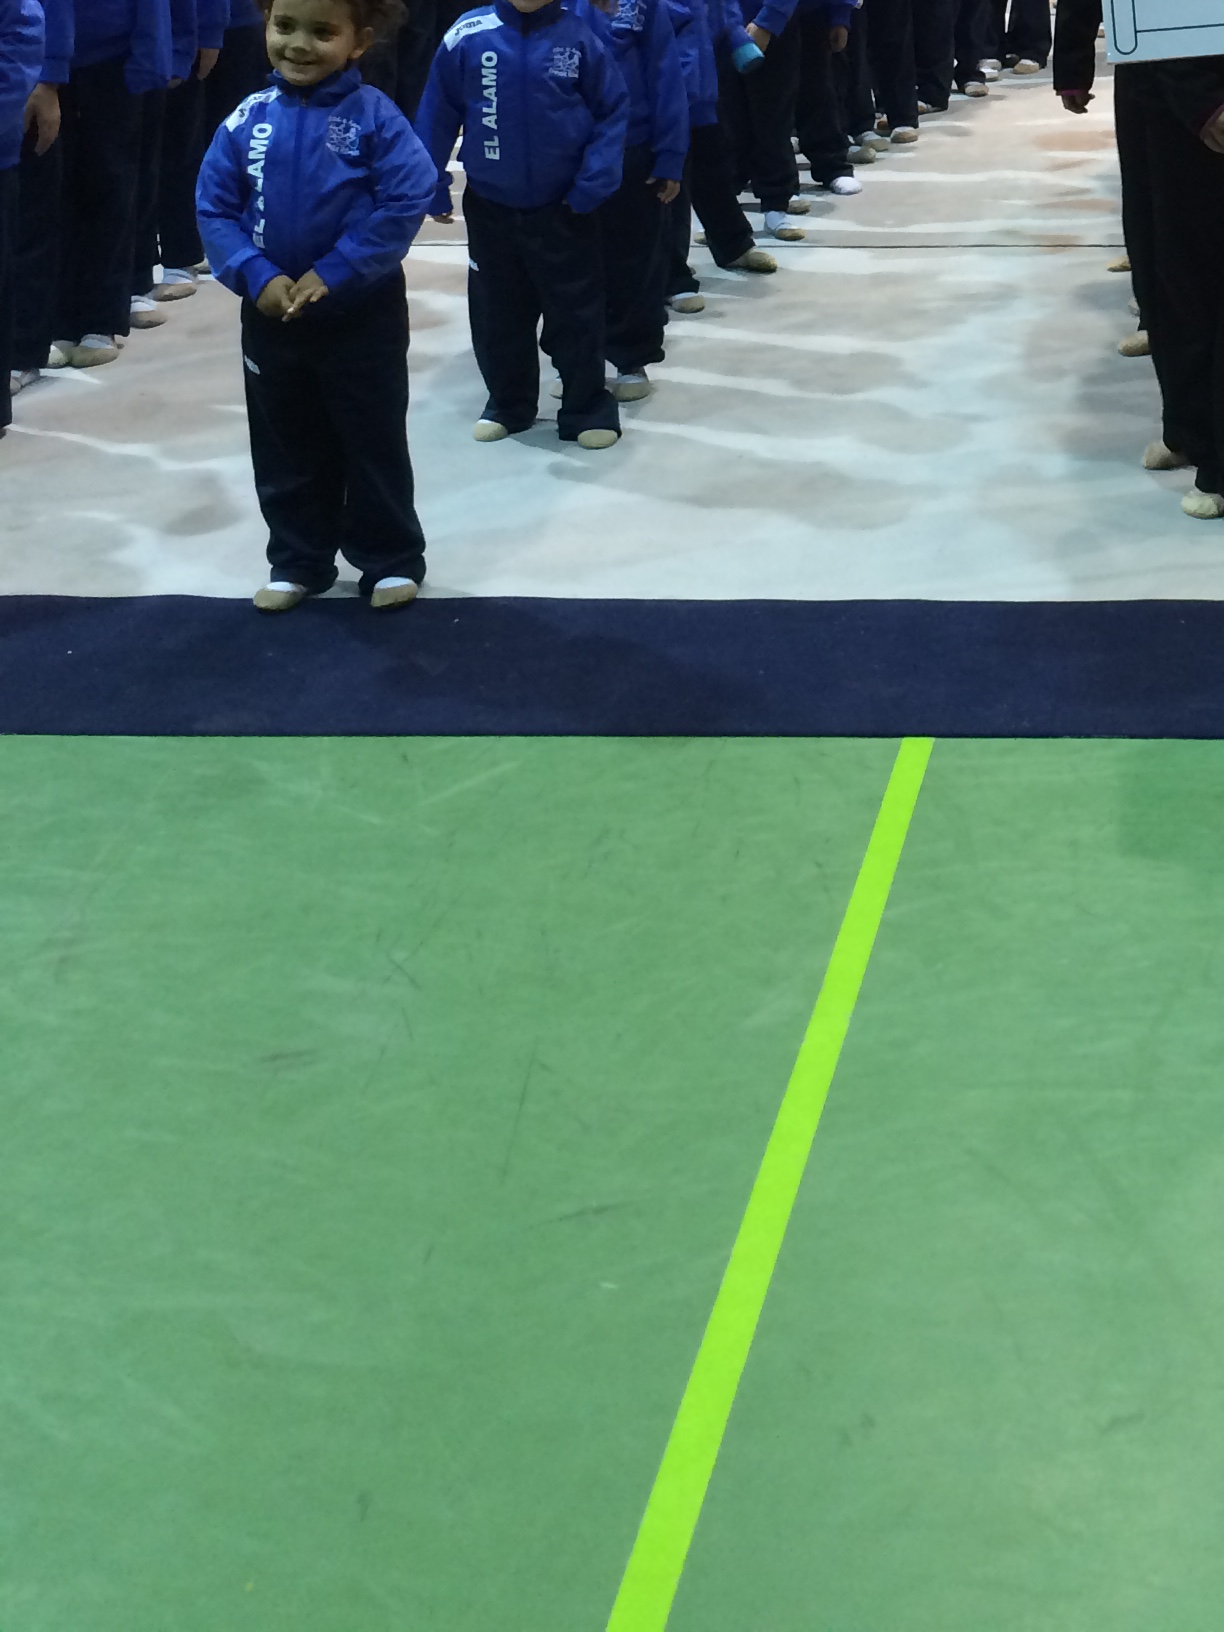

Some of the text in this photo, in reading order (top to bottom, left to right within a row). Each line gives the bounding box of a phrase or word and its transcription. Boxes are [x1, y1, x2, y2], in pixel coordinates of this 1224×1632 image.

[481, 50, 498, 130] ALAMO
[483, 135, 500, 161] EL
[252, 218, 266, 249] EL
